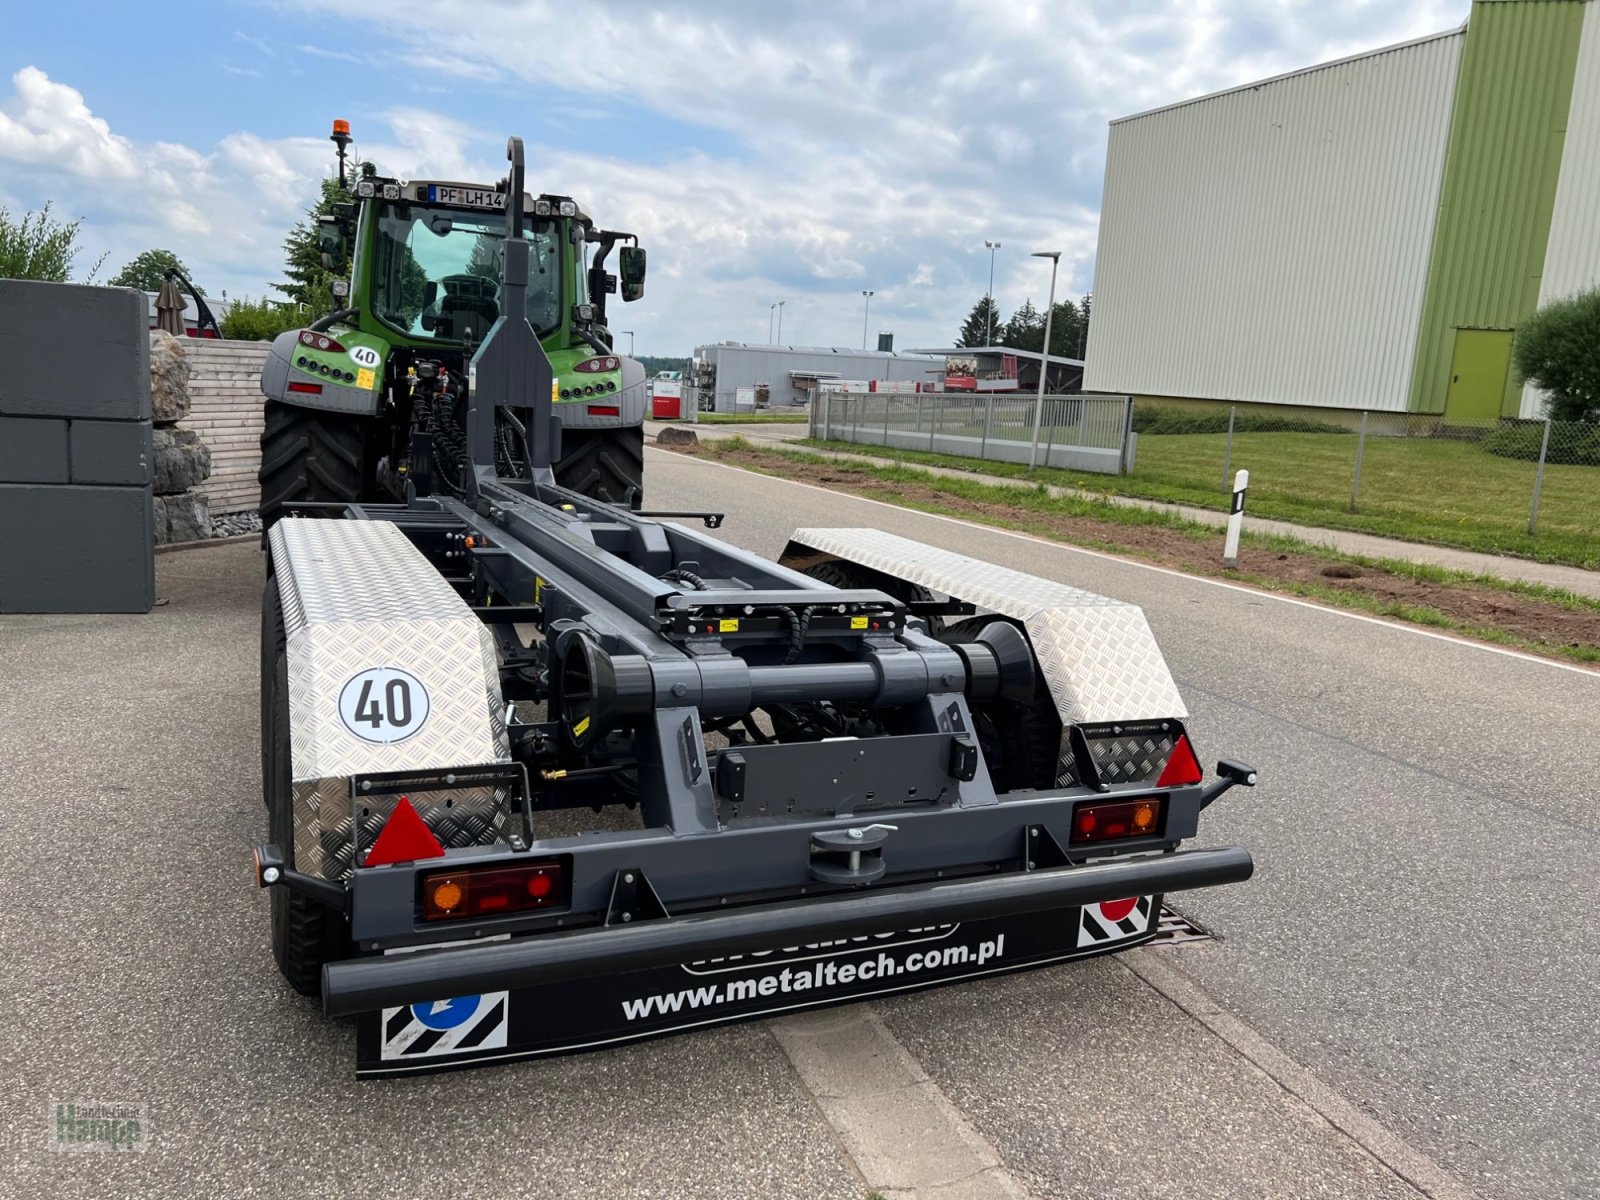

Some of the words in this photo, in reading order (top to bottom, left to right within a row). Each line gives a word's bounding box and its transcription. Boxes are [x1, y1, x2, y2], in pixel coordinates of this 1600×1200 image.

[440, 188, 457, 202] PF
[355, 348, 375, 364] 40
[354, 678, 412, 728] 40
[621, 933, 1005, 1021] www.metaltech.com.pl
